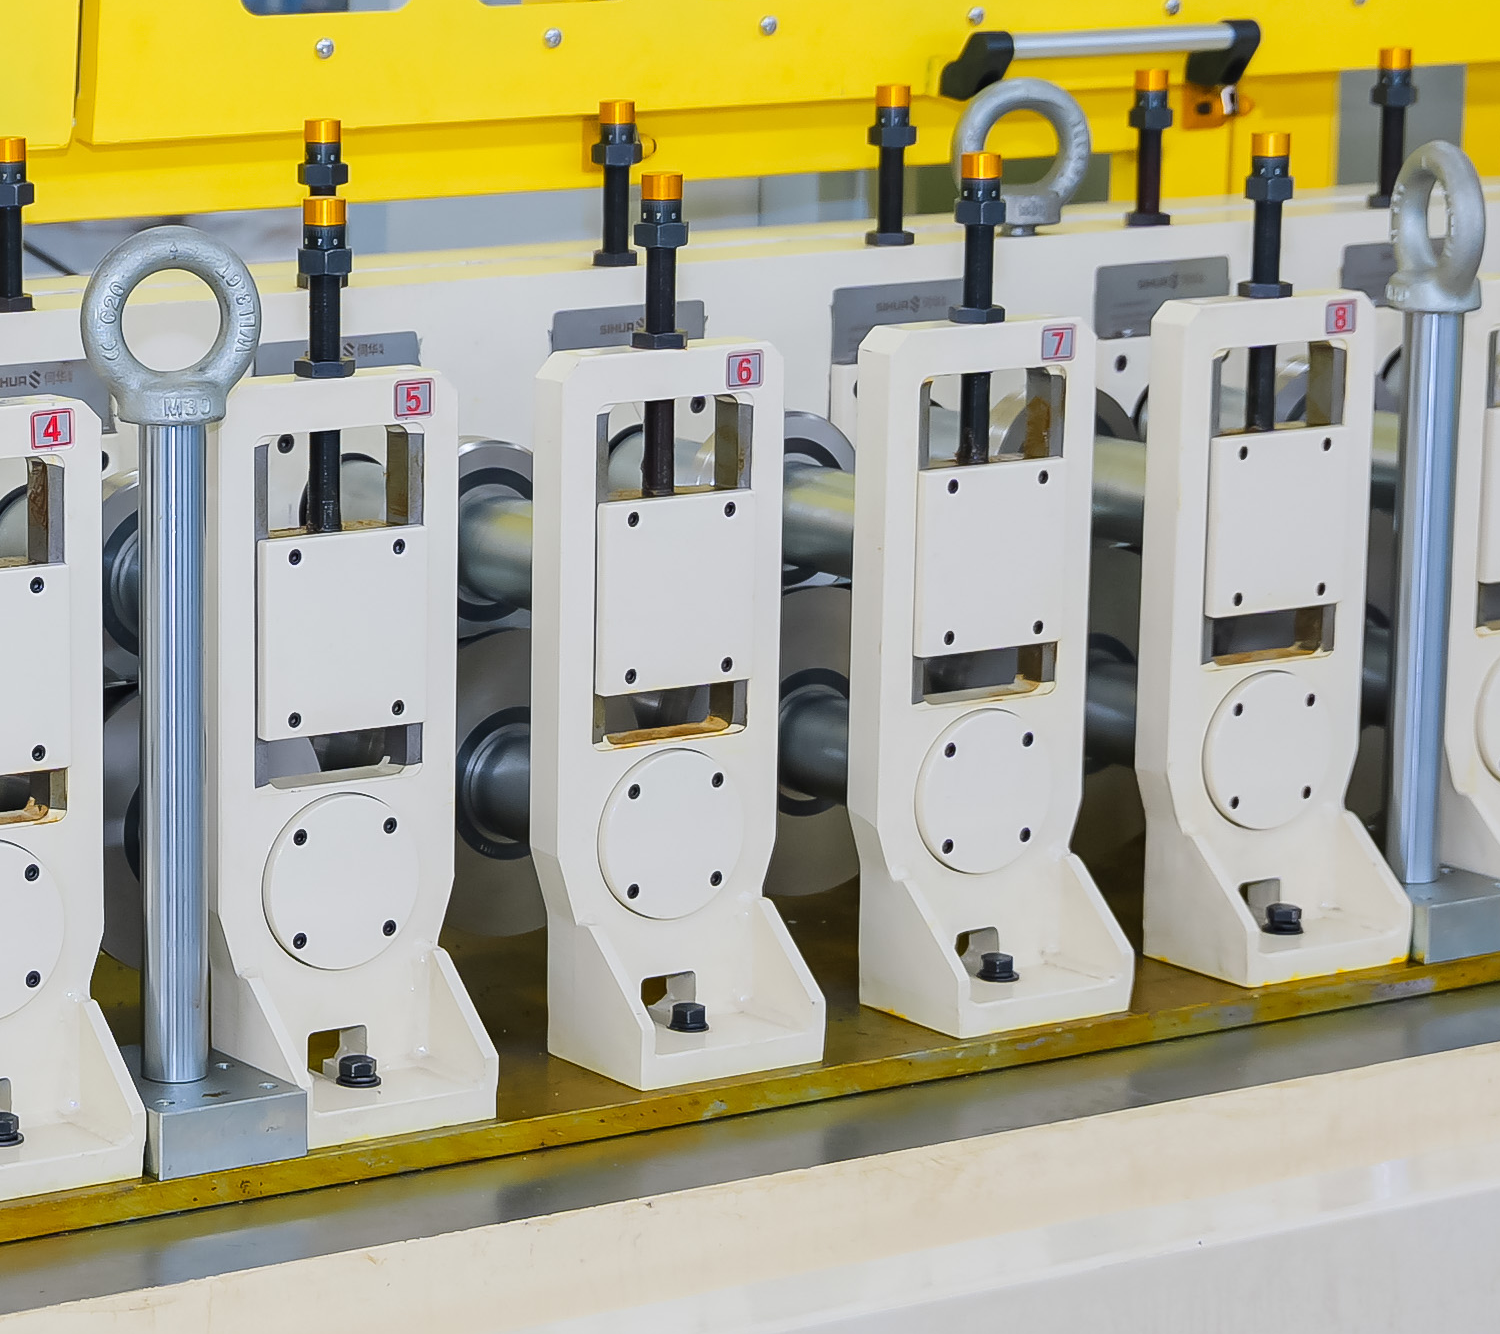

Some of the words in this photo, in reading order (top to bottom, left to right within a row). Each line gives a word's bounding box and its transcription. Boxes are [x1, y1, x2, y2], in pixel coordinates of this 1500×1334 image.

[100, 281, 125, 325] C20
[600, 322, 634, 335] SIHUA
[1335, 306, 1346, 330] 8
[1052, 332, 1064, 356] 7
[737, 358, 752, 384] 6
[164, 396, 212, 417] M30
[406, 386, 422, 412] 5
[43, 415, 62, 442] 4
